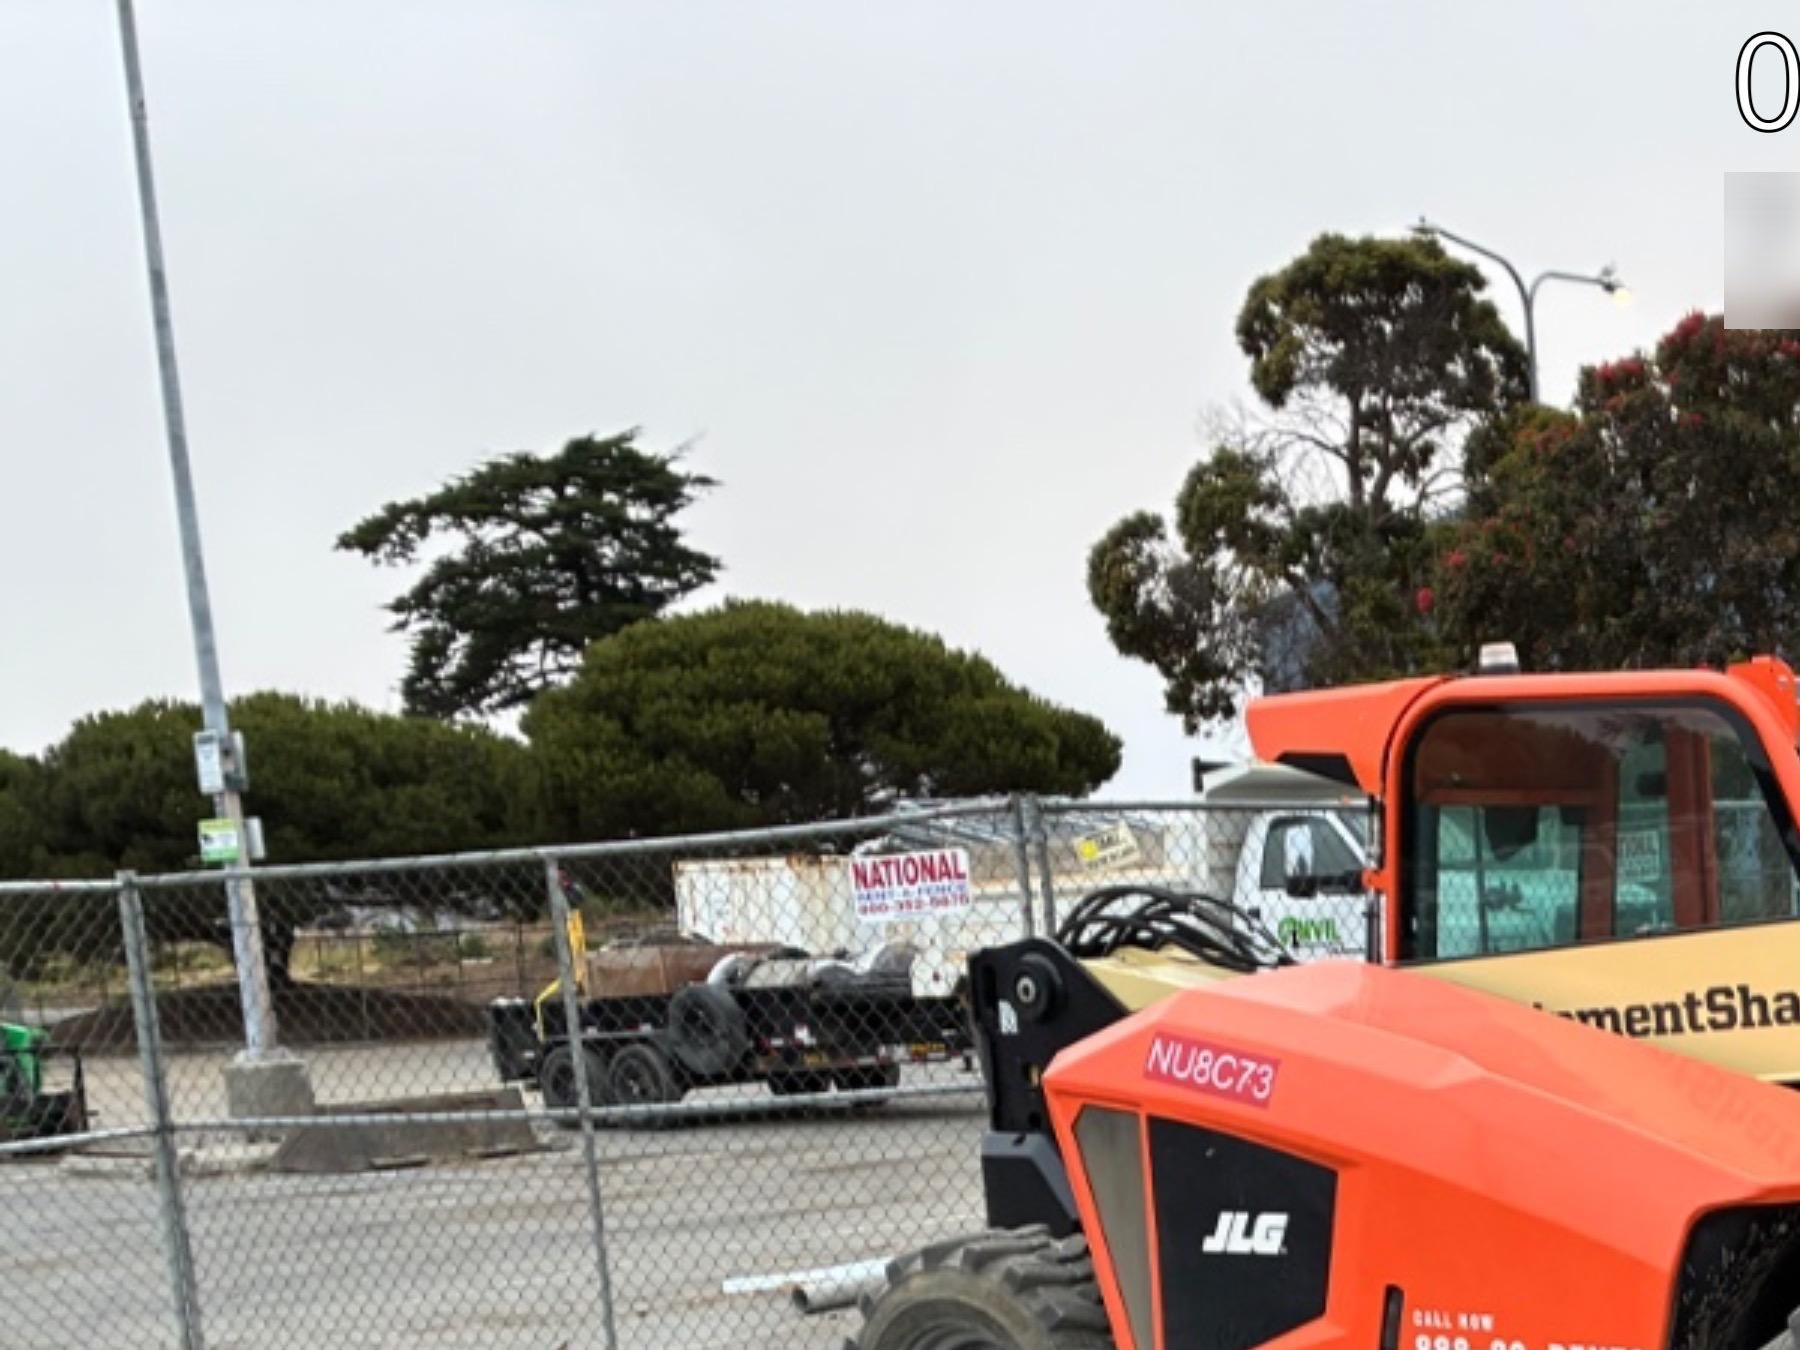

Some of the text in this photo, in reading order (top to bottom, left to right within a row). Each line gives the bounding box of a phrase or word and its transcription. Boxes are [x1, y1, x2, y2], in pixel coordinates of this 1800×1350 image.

[851, 850, 967, 890] NATIONAL
[1147, 1038, 1275, 1100] NU8C73
[1202, 1211, 1288, 1254] JLG
[1412, 1309, 1495, 1333] CALL NOW
